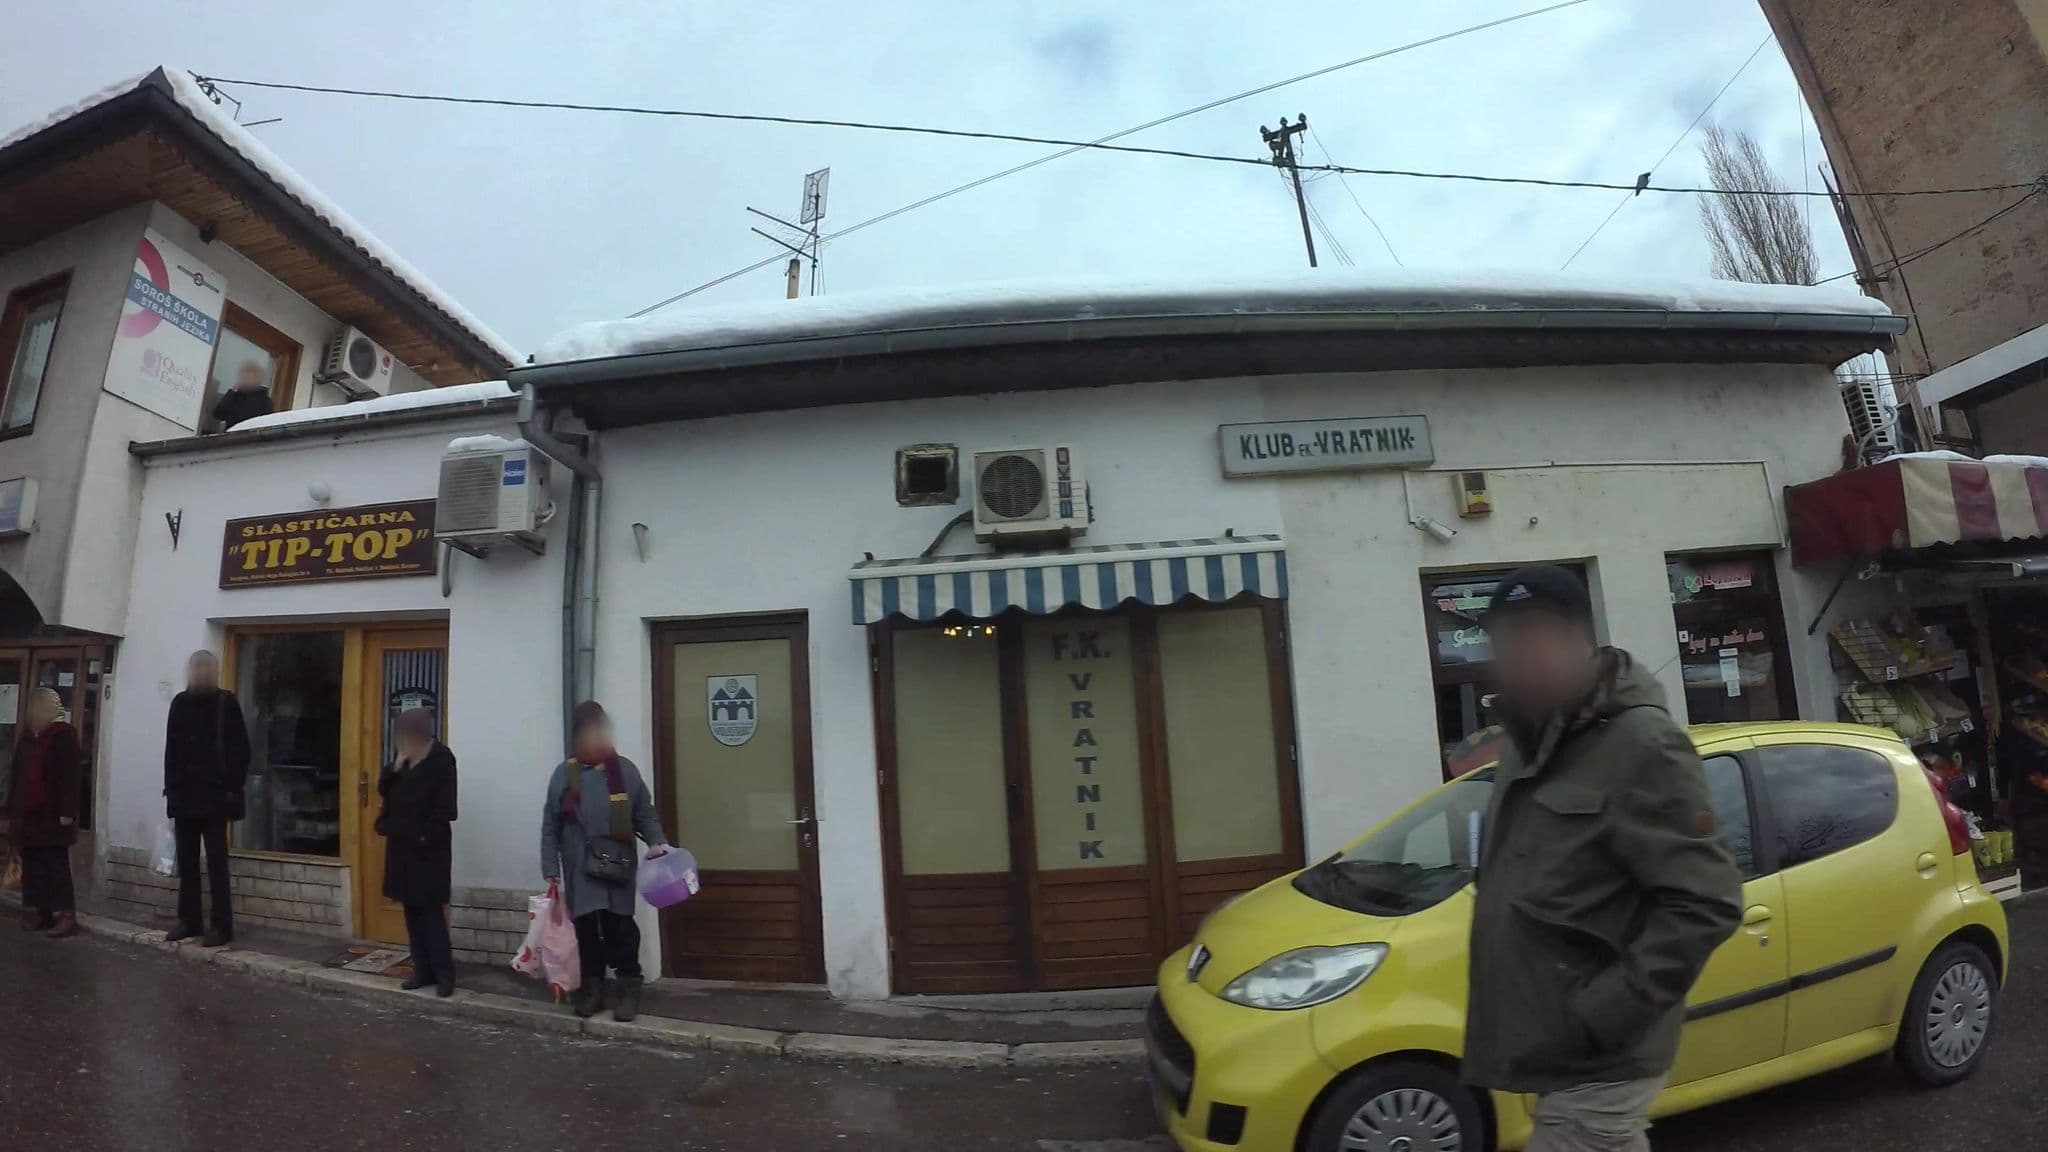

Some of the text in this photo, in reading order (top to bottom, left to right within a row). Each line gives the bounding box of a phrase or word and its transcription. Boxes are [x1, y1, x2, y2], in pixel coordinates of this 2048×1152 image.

[134, 279, 207, 329] SOROŠ ŠKOLA
[141, 296, 210, 342] STRANIH JEZIKA
[1240, 432, 1294, 460] KLUB
[242, 511, 416, 537] SLASTIČARNA
[1051, 632, 1112, 660] F.K.
[1068, 673, 1104, 860] VRATNIK
